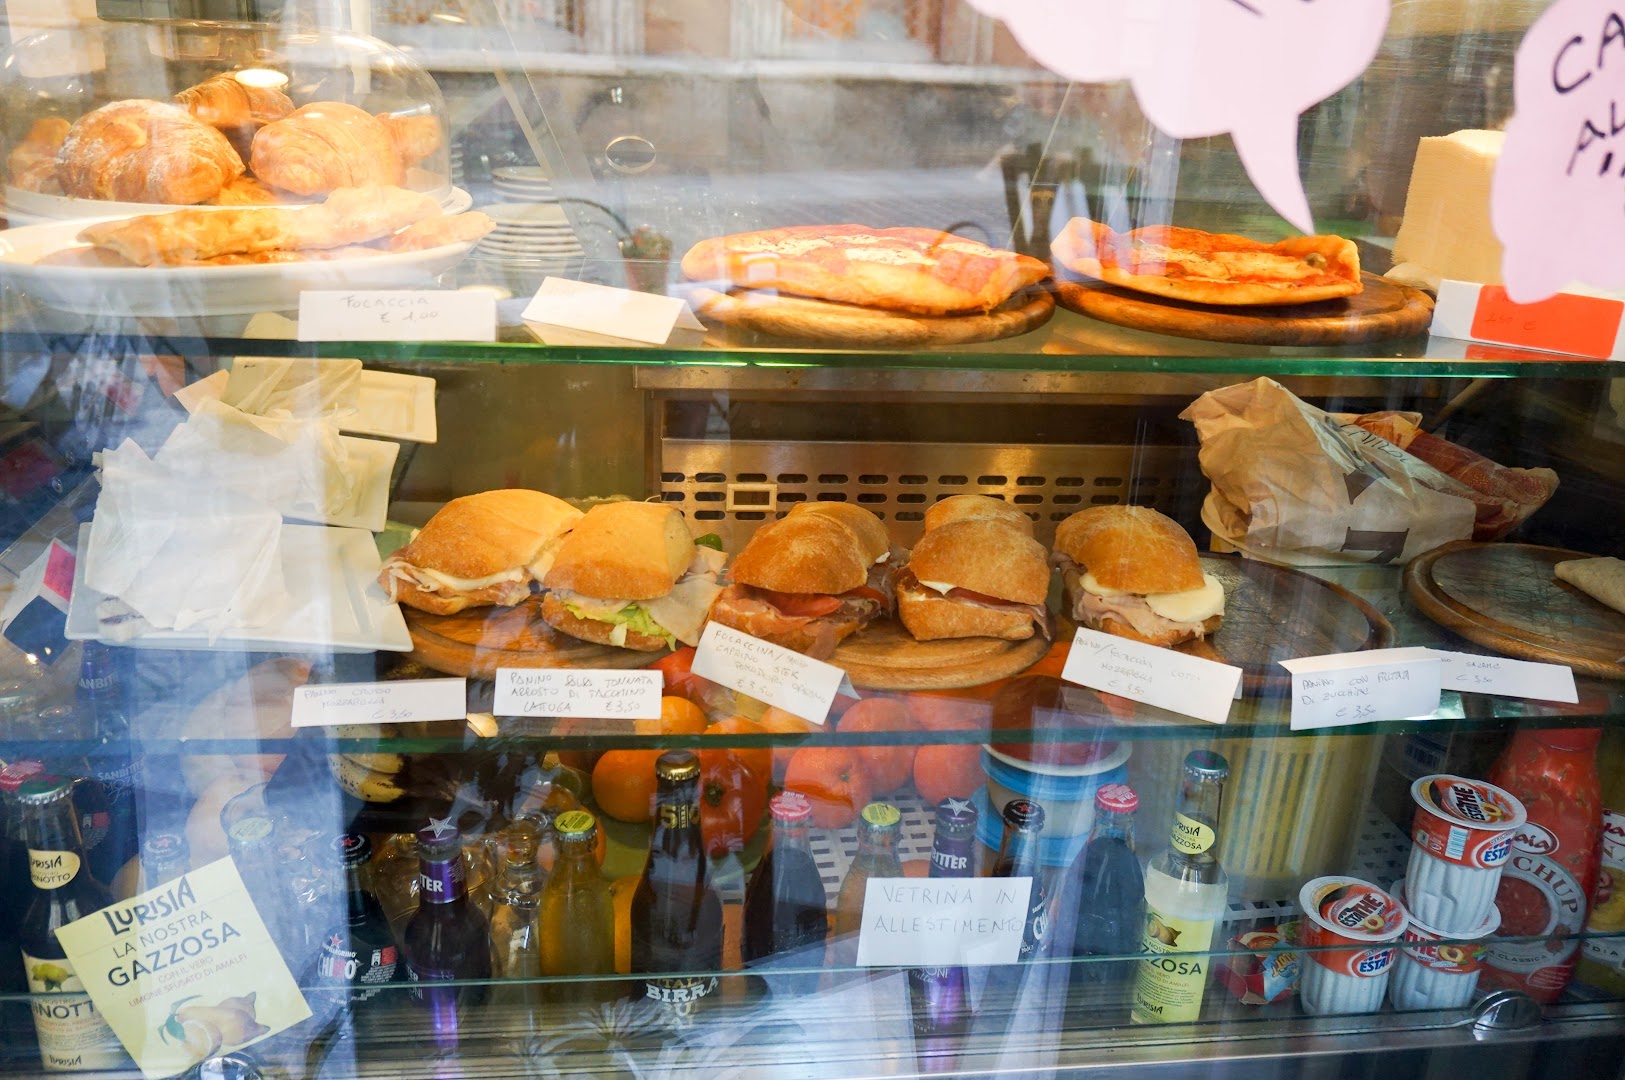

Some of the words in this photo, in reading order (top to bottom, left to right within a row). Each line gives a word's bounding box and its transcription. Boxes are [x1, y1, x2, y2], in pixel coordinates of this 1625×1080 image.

[341, 295, 429, 309] FOCACCIA
[510, 672, 552, 685] PANINO
[605, 676, 654, 689] TONNATA
[511, 686, 559, 697] ARROSTO
[883, 884, 973, 904] VETRINA
[995, 888, 1017, 905] IN
[1513, 856, 1578, 914] CHUP
[103, 874, 197, 936] LURISIA
[112, 942, 137, 959] LA
[139, 909, 213, 948] NOSTRA
[874, 915, 1024, 934] ALLESTIMENTO
[107, 921, 241, 987] GAZZOSA
[189, 955, 214, 972] VERO
[128, 986, 163, 1008] LIMONE
[163, 971, 203, 994] SFUSATO
[214, 953, 248, 973] AMALFI
[645, 976, 719, 1003] BIRRA
